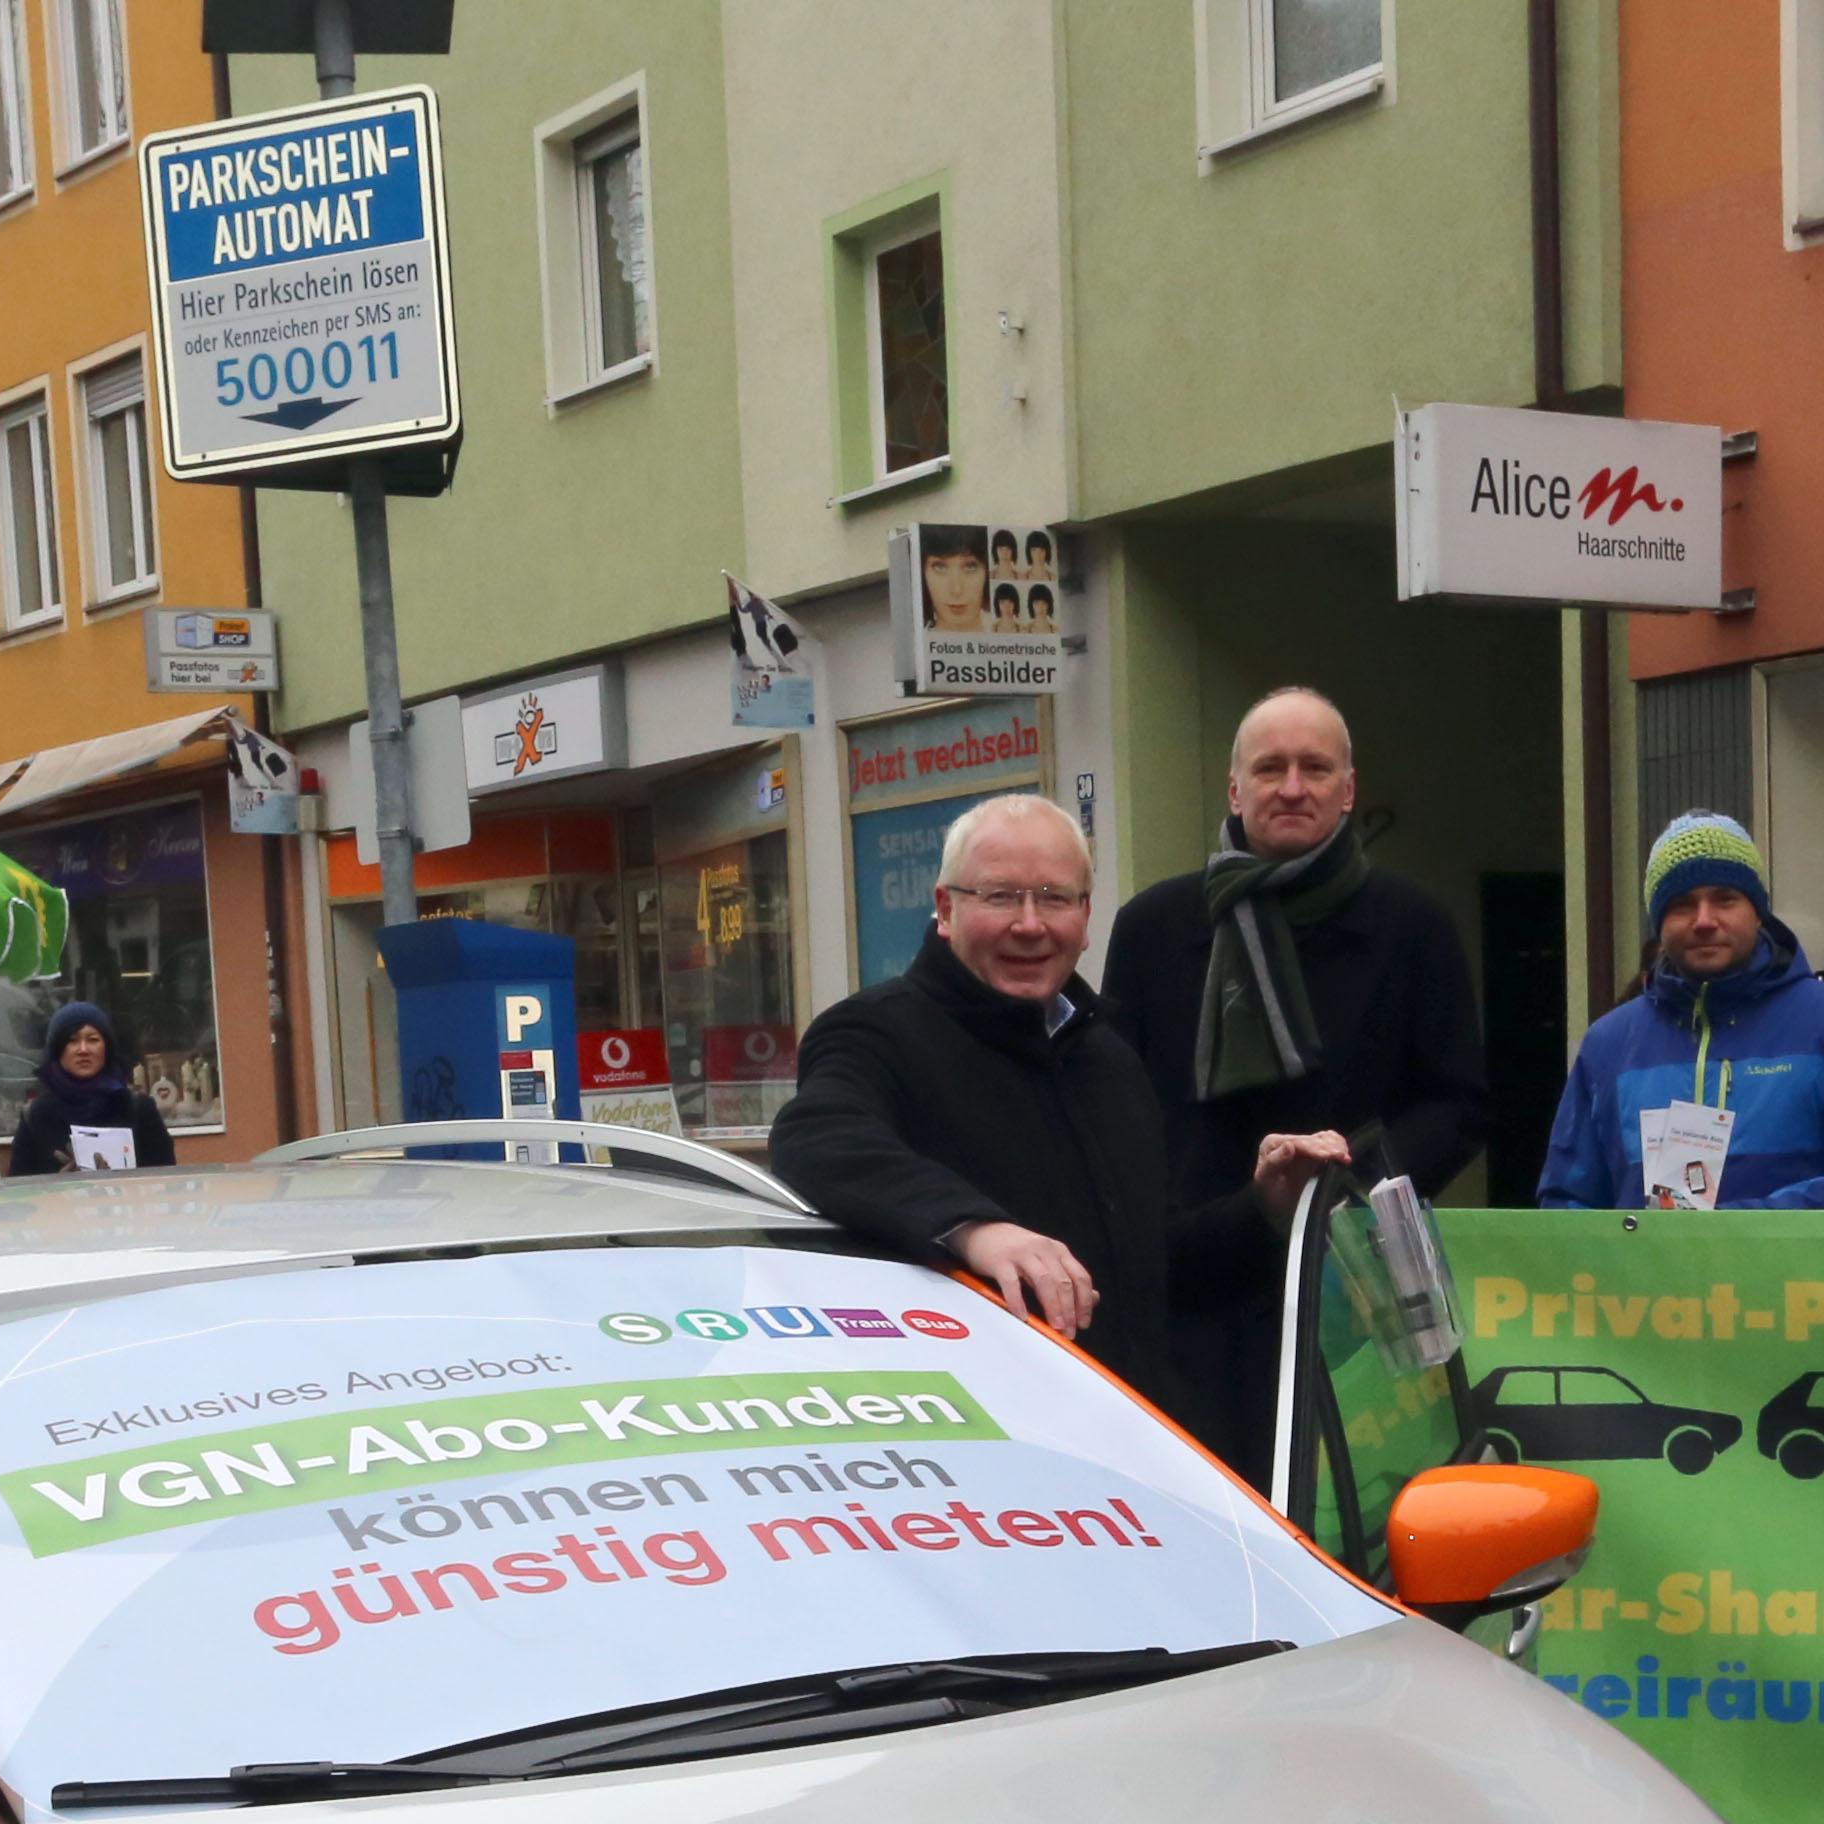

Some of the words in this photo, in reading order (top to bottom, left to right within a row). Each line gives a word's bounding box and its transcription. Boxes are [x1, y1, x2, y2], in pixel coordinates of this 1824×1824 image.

[168, 125, 410, 213] PARKSCHEIN-
[213, 189, 373, 265] AUTOMAT
[180, 290, 226, 320] Hier
[234, 267, 354, 312] Parkschein
[362, 259, 419, 290] lösen
[184, 334, 219, 356] oder
[223, 318, 320, 350] Kennzeichen
[325, 314, 350, 338] per
[355, 301, 392, 328] SMS
[397, 302, 422, 322] an:
[216, 331, 400, 407] 500011
[1471, 457, 1571, 520] Alice
[1577, 532, 1686, 562] Haarschnitte
[218, 634, 246, 645] SHOP
[929, 641, 963, 656] Fotos
[966, 642, 976, 656] &
[977, 641, 1057, 657] biometrische
[169, 661, 220, 672] Passfotos
[171, 673, 191, 683] hier
[195, 673, 211, 683] bei
[930, 660, 1057, 685] Passbilder
[850, 745, 908, 794] Jetzt
[913, 716, 1039, 776] wechseln
[1078, 775, 1093, 799] 30
[504, 994, 544, 1043] P
[592, 1069, 647, 1083] vodafone
[591, 1099, 673, 1122] Vodafone
[607, 1314, 663, 1343] S
[686, 1312, 736, 1338] R
[756, 1307, 816, 1336] U
[832, 1316, 897, 1331] Tram
[910, 1316, 960, 1331] Bus
[44, 1379, 328, 1449] Exklusives
[343, 1353, 573, 1399] Angebot:
[30, 1385, 968, 1524] VGN-Abo-Kunden
[326, 1464, 707, 1553] können
[725, 1449, 960, 1504] mich
[249, 1522, 730, 1657] günstig
[743, 1497, 1165, 1563] mieten!
